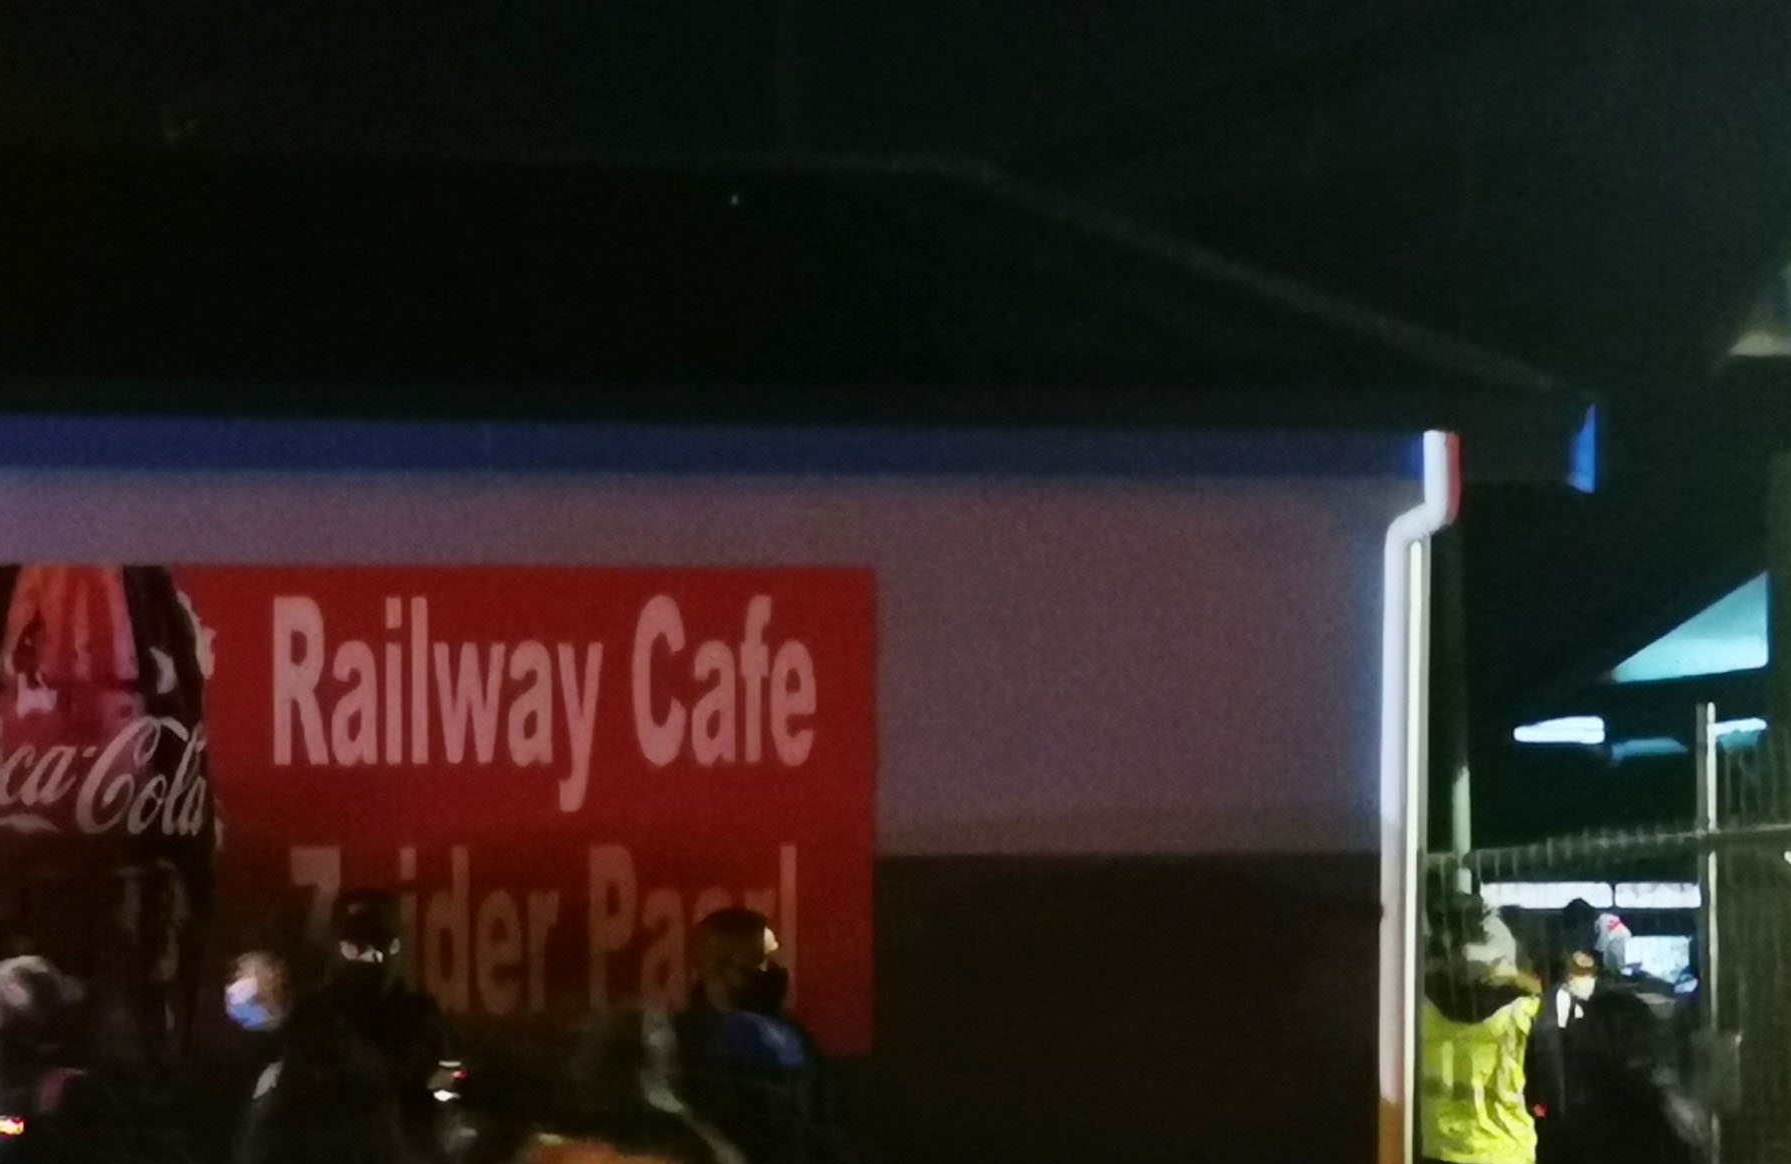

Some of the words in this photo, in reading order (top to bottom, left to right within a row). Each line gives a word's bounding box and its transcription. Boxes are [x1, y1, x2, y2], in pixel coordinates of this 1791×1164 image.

[272, 595, 603, 813] Railway
[632, 594, 817, 769] Cafe
[289, 844, 560, 1014] Zider
[588, 843, 797, 1013] Pal
